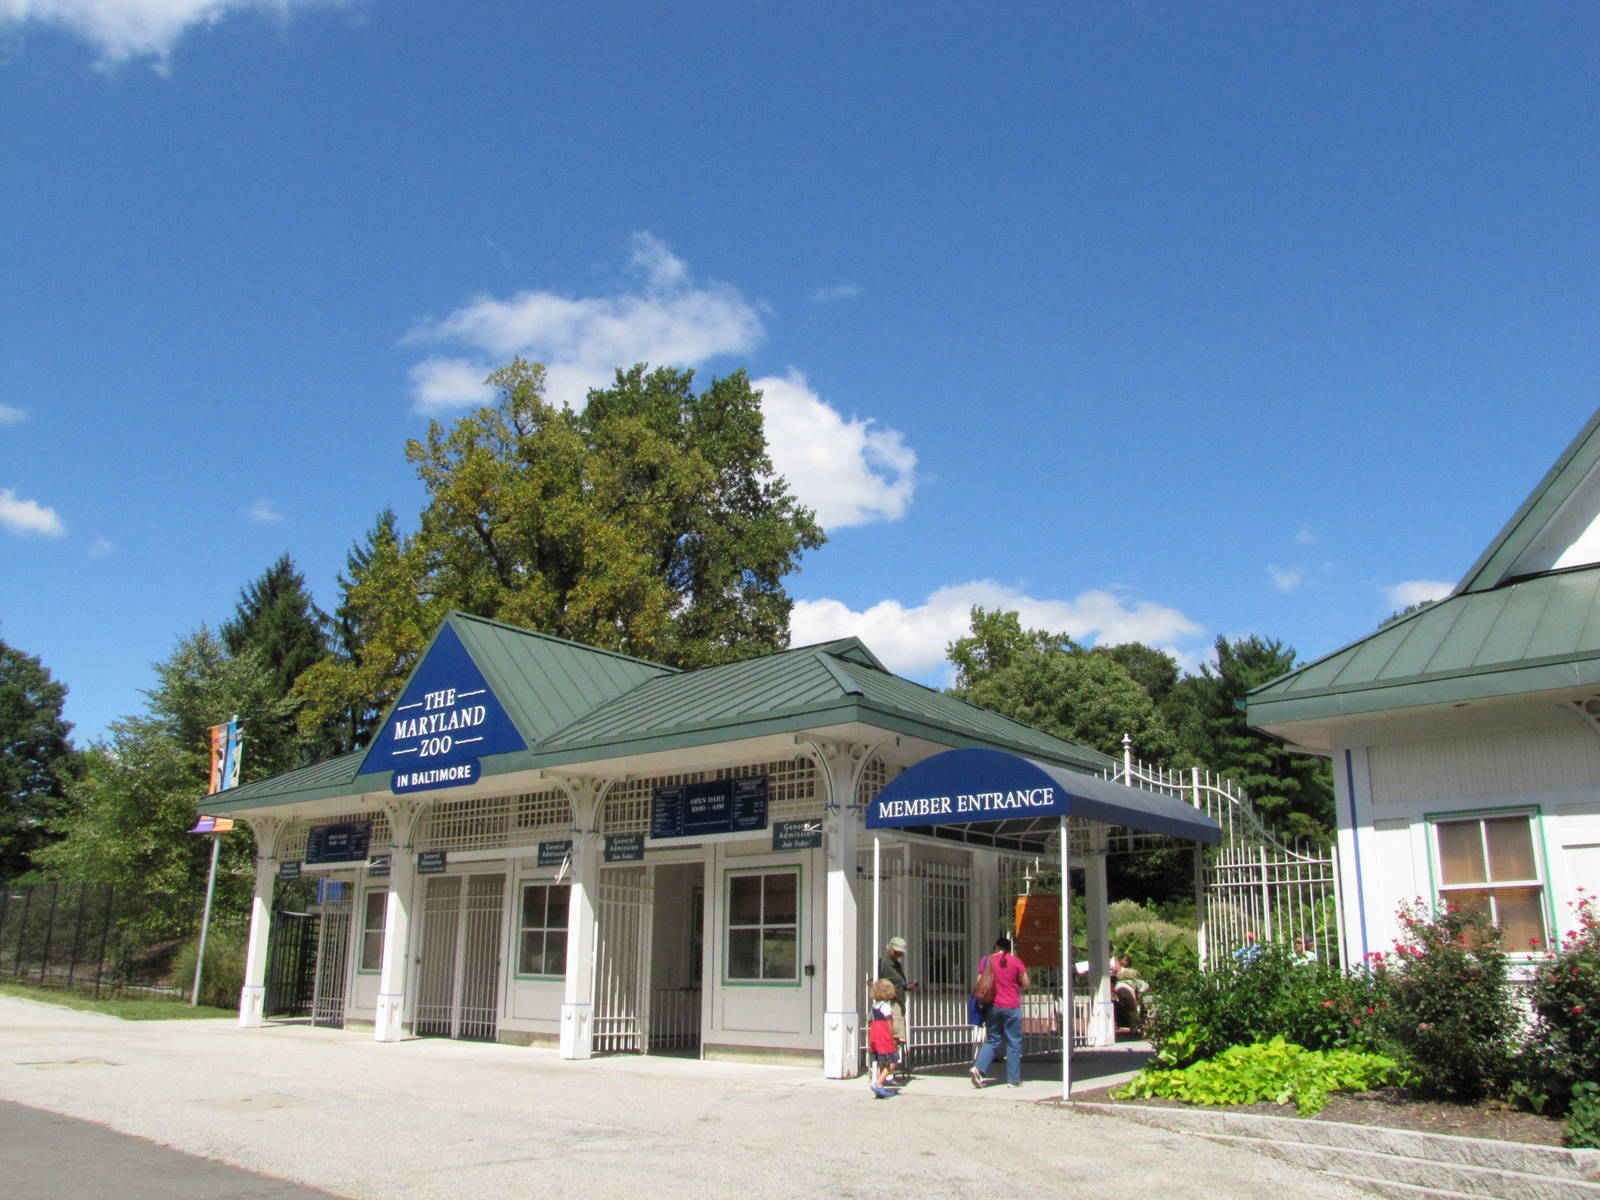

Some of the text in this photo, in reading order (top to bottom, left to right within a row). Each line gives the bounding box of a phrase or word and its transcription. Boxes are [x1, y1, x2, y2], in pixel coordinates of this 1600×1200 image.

[424, 688, 456, 711] THE
[394, 705, 486, 740] MARYLAND
[420, 735, 452, 758] ZOO
[397, 764, 471, 788] IN BALTIMORE
[690, 793, 726, 805] OPEN DAILY
[879, 787, 1054, 818] MEMBER ENTRANCE
[610, 843, 639, 851] Admission
[613, 835, 636, 845] General
[779, 831, 816, 840] Admission
